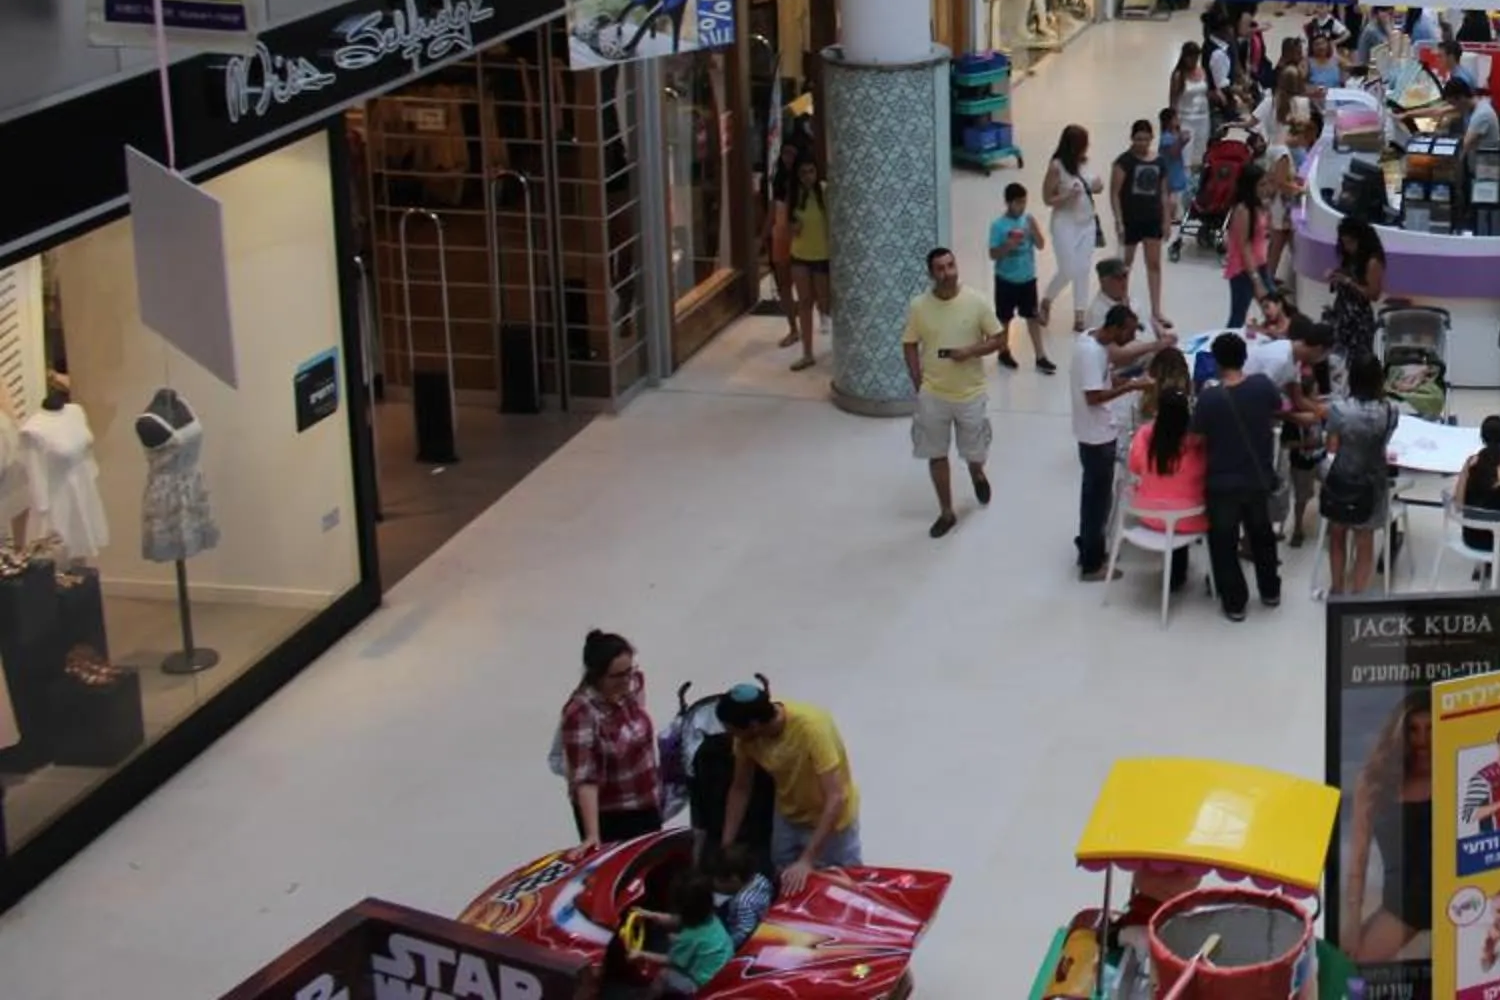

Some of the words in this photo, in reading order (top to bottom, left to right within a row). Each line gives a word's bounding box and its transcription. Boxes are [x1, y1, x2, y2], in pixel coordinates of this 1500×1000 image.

[1350, 617, 1416, 643] JACK
[1424, 614, 1493, 635] KUBA
[371, 932, 543, 1000] STAR
